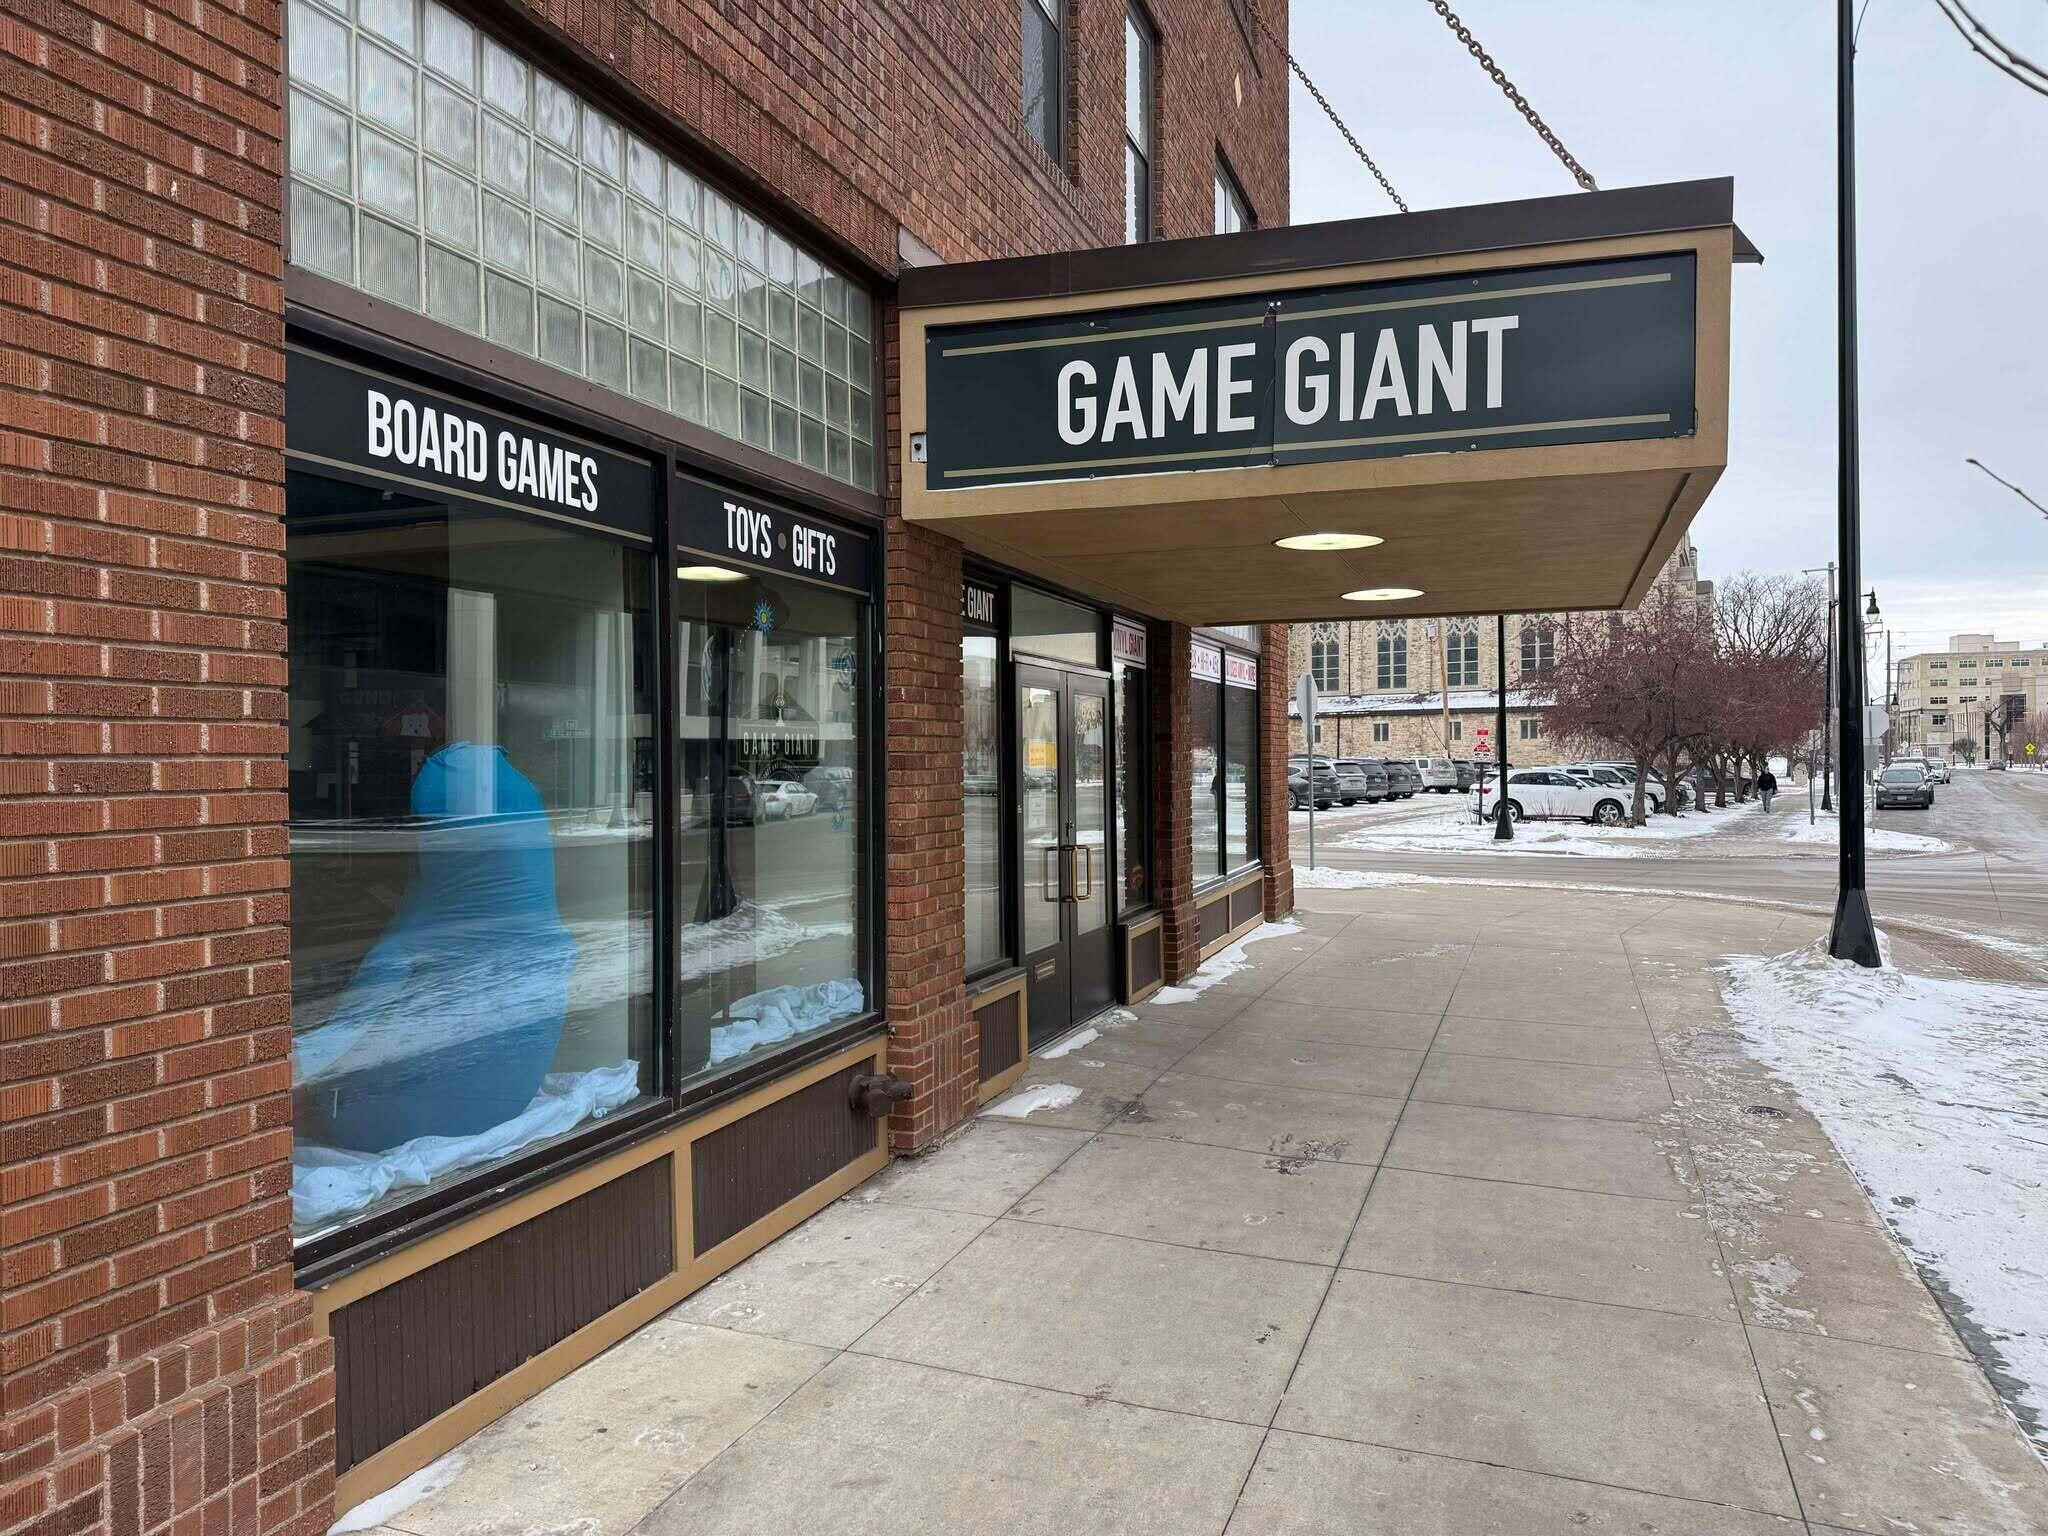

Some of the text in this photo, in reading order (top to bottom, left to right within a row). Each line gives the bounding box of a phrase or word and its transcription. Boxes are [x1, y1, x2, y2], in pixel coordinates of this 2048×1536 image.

[1057, 315, 1519, 446] GAME GIANT
[367, 390, 598, 512] BOARD GAMES
[723, 501, 836, 576] TOYS GIFTS
[967, 586, 994, 623] GIANT
[743, 731, 813, 756] GAME GIANT
